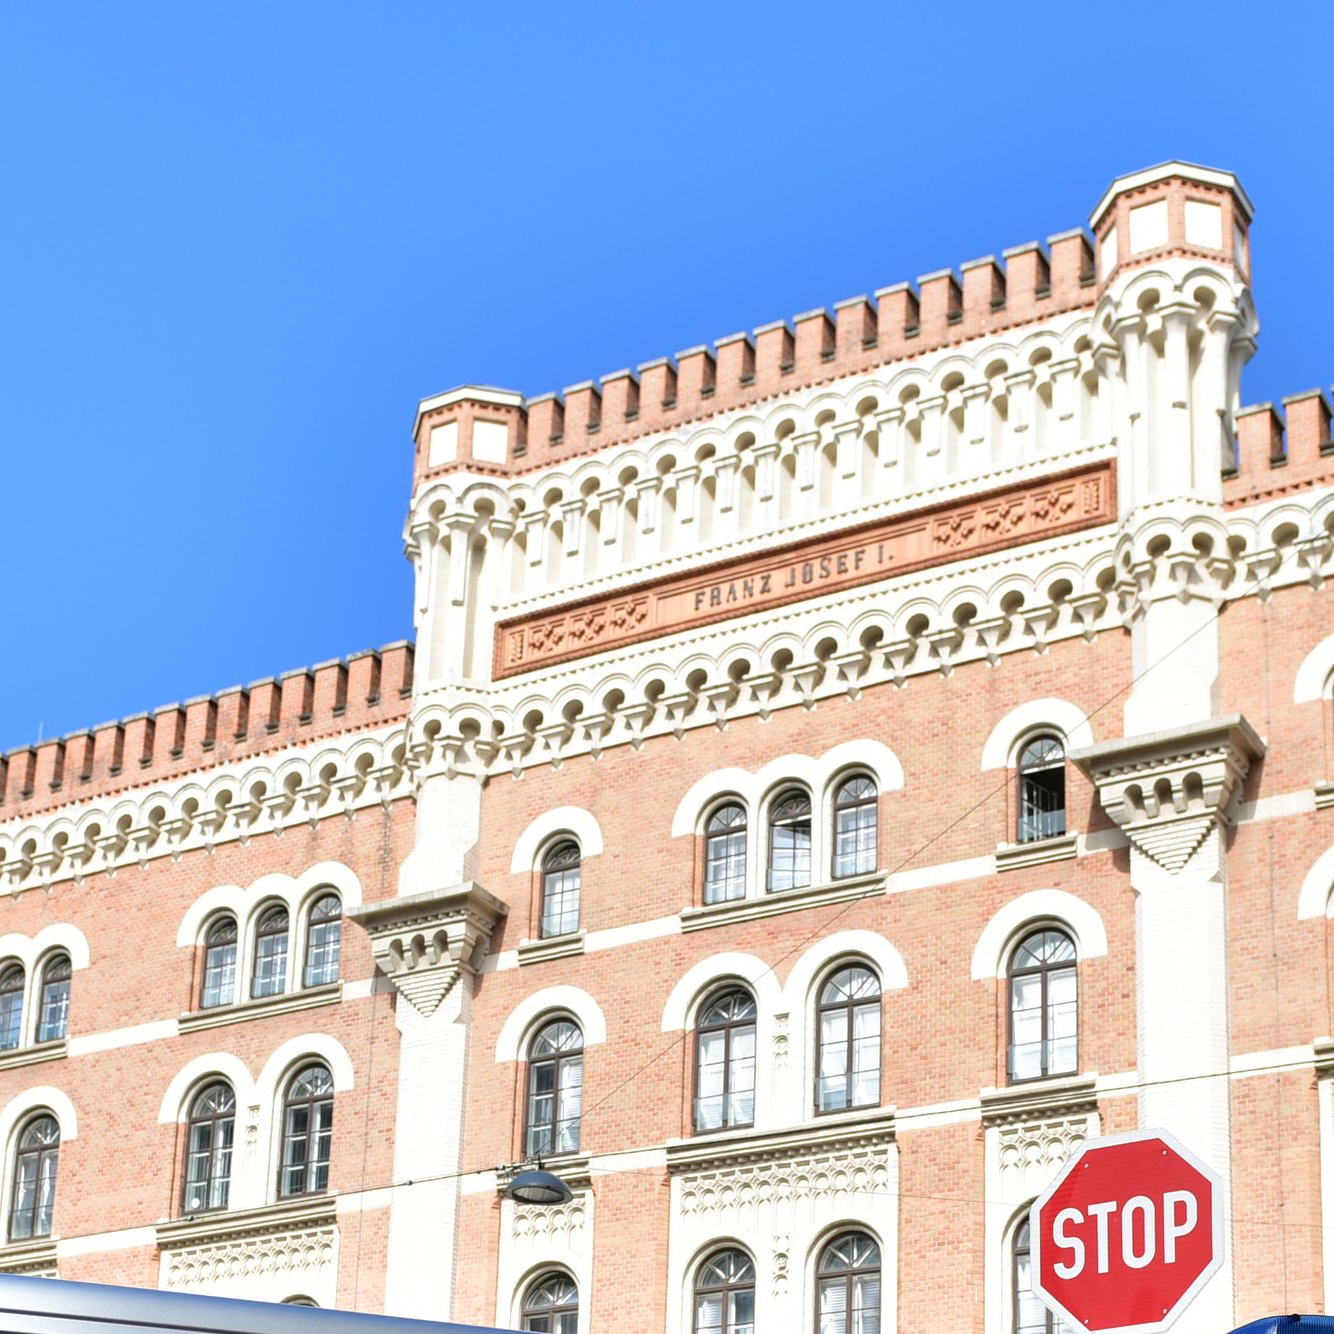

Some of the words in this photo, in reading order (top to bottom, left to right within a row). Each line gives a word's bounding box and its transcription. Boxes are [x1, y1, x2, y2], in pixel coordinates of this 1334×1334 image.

[694, 574, 772, 611] FRANZ
[784, 550, 865, 588] JOSEF
[1053, 1190, 1198, 1280] STOP
